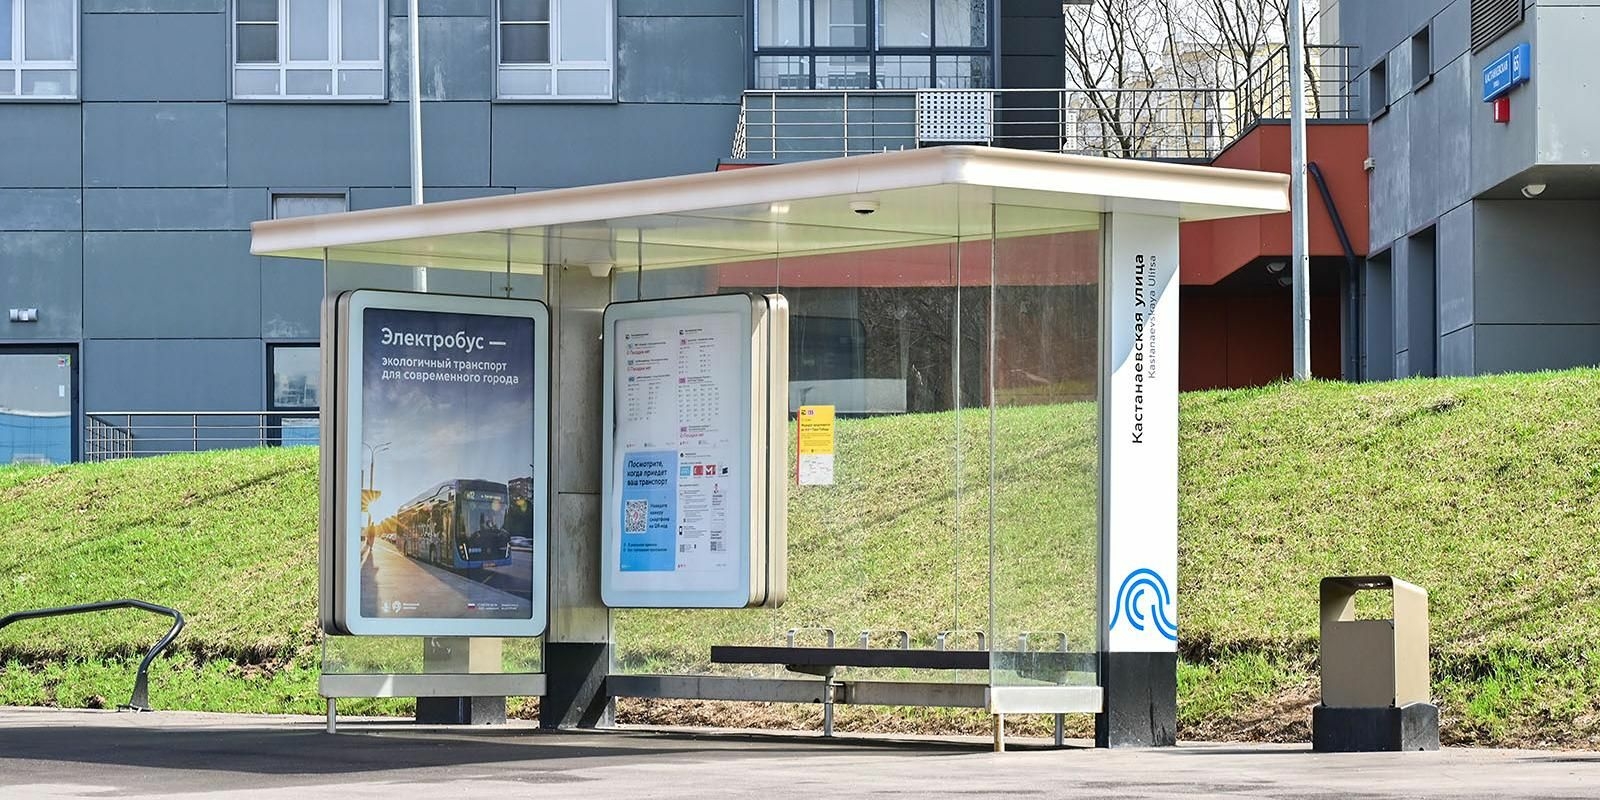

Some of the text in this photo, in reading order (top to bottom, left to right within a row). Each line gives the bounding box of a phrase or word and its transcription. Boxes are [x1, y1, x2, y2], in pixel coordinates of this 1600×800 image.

[1148, 255, 1157, 379] Kastanaevskaya Ulitsa
[381, 327, 484, 353] Электробус
[1132, 254, 1146, 443] Кастанаевская улица
[382, 357, 507, 373] экологичный транспорт
[382, 370, 519, 385] для современного города
[627, 460, 664, 469] Посмотрите,
[627, 469, 667, 478] когда приедет
[639, 479, 668, 487] транспорт
